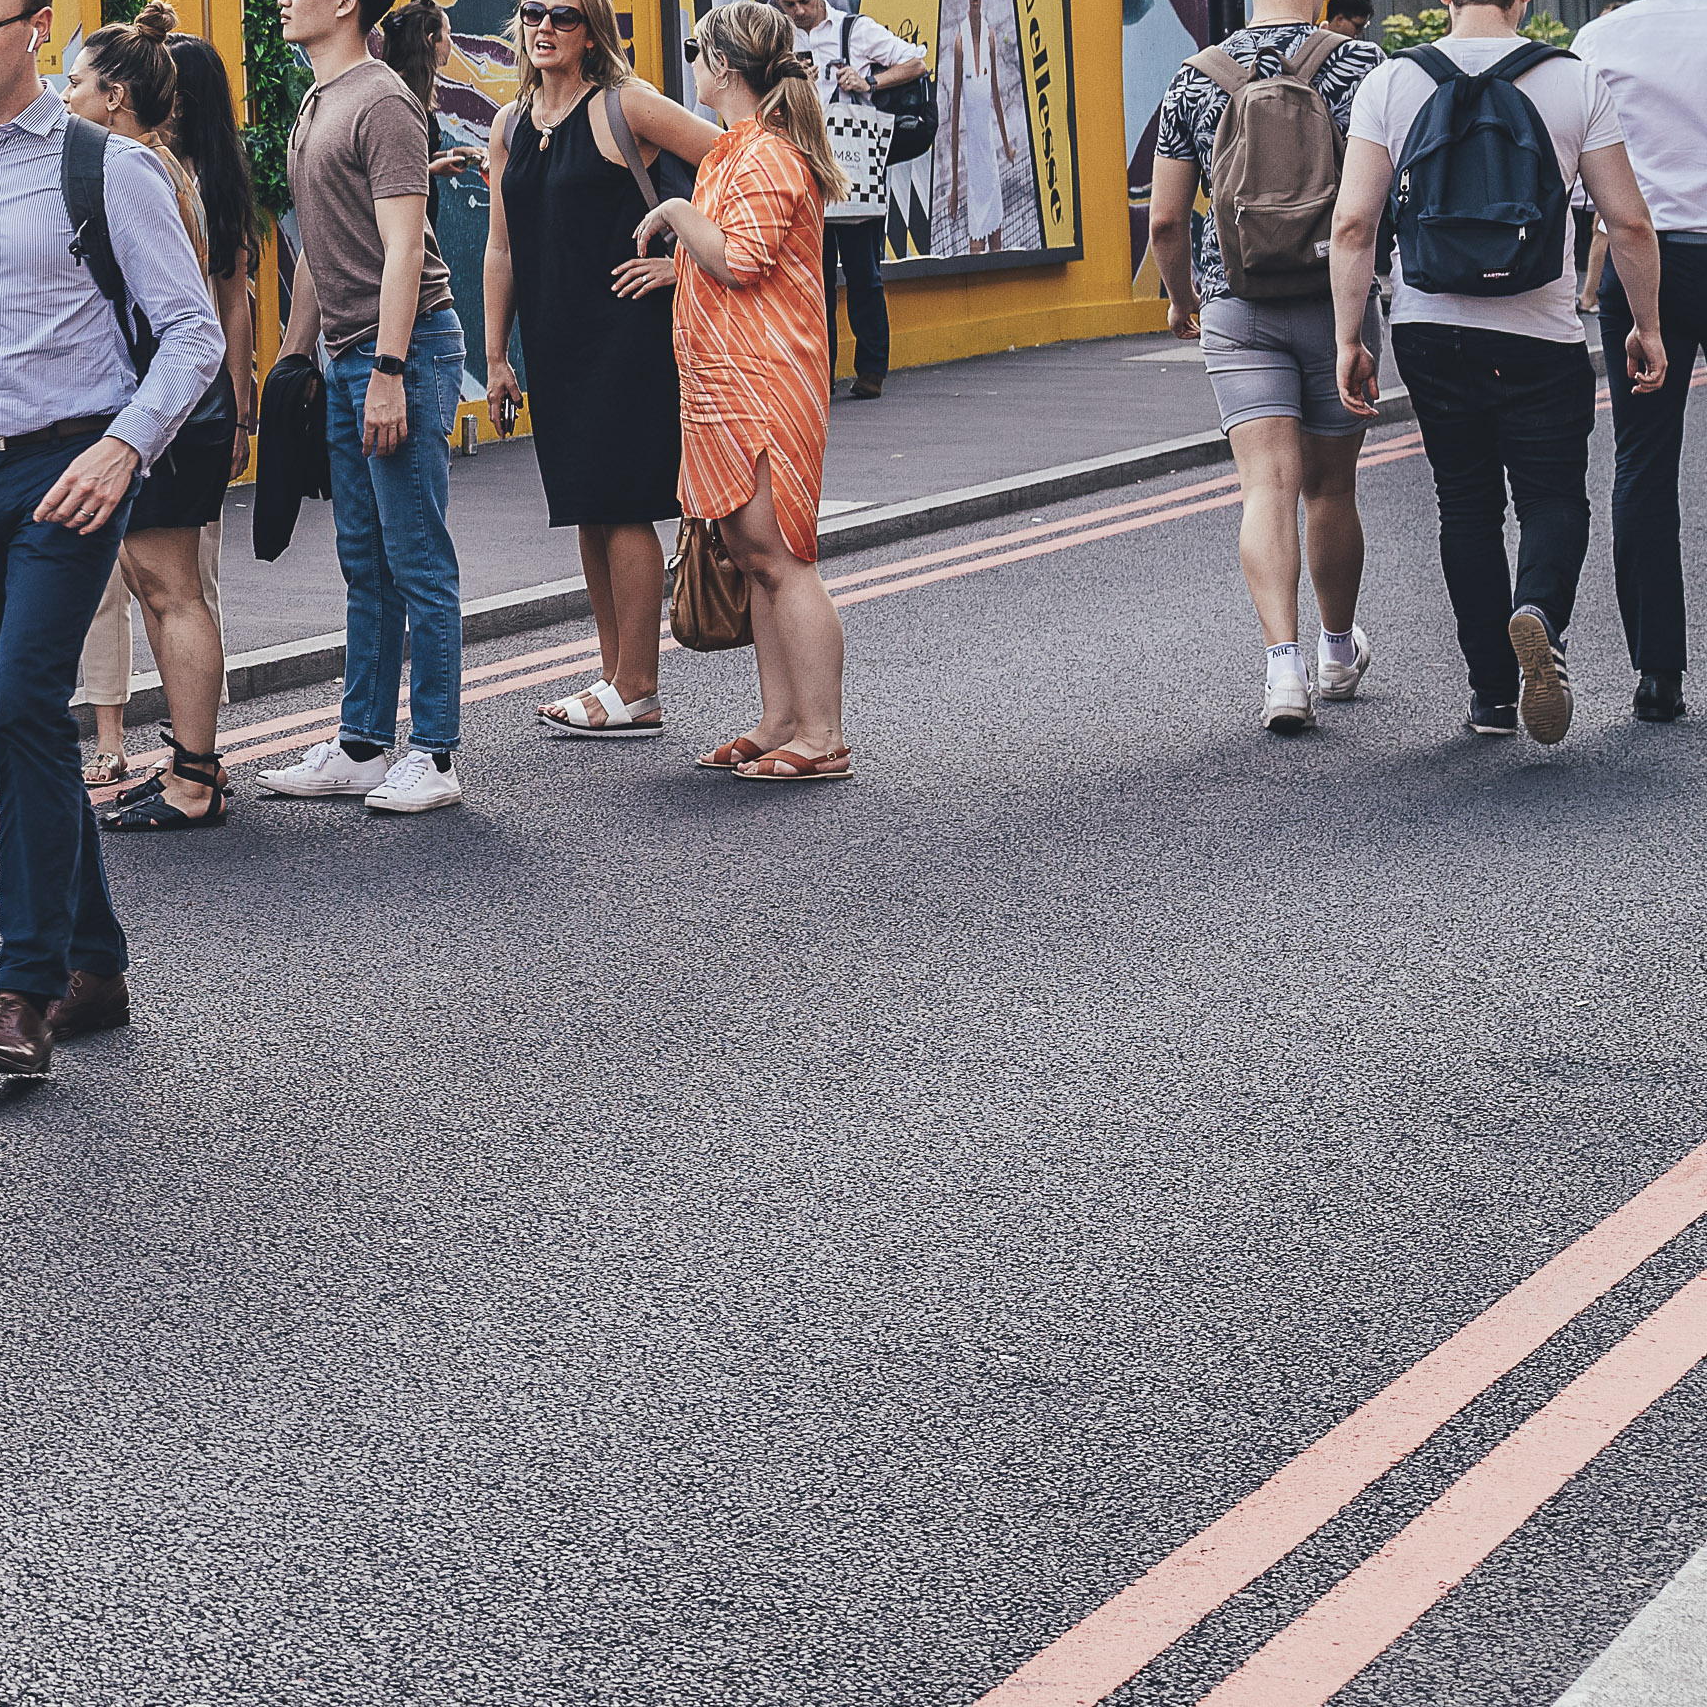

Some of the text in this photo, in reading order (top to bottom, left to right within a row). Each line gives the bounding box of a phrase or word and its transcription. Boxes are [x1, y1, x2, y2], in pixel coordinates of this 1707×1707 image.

[1029, 17, 1063, 227] ellesse
[833, 150, 861, 163] M&S
[1272, 647, 1291, 659] ARE
